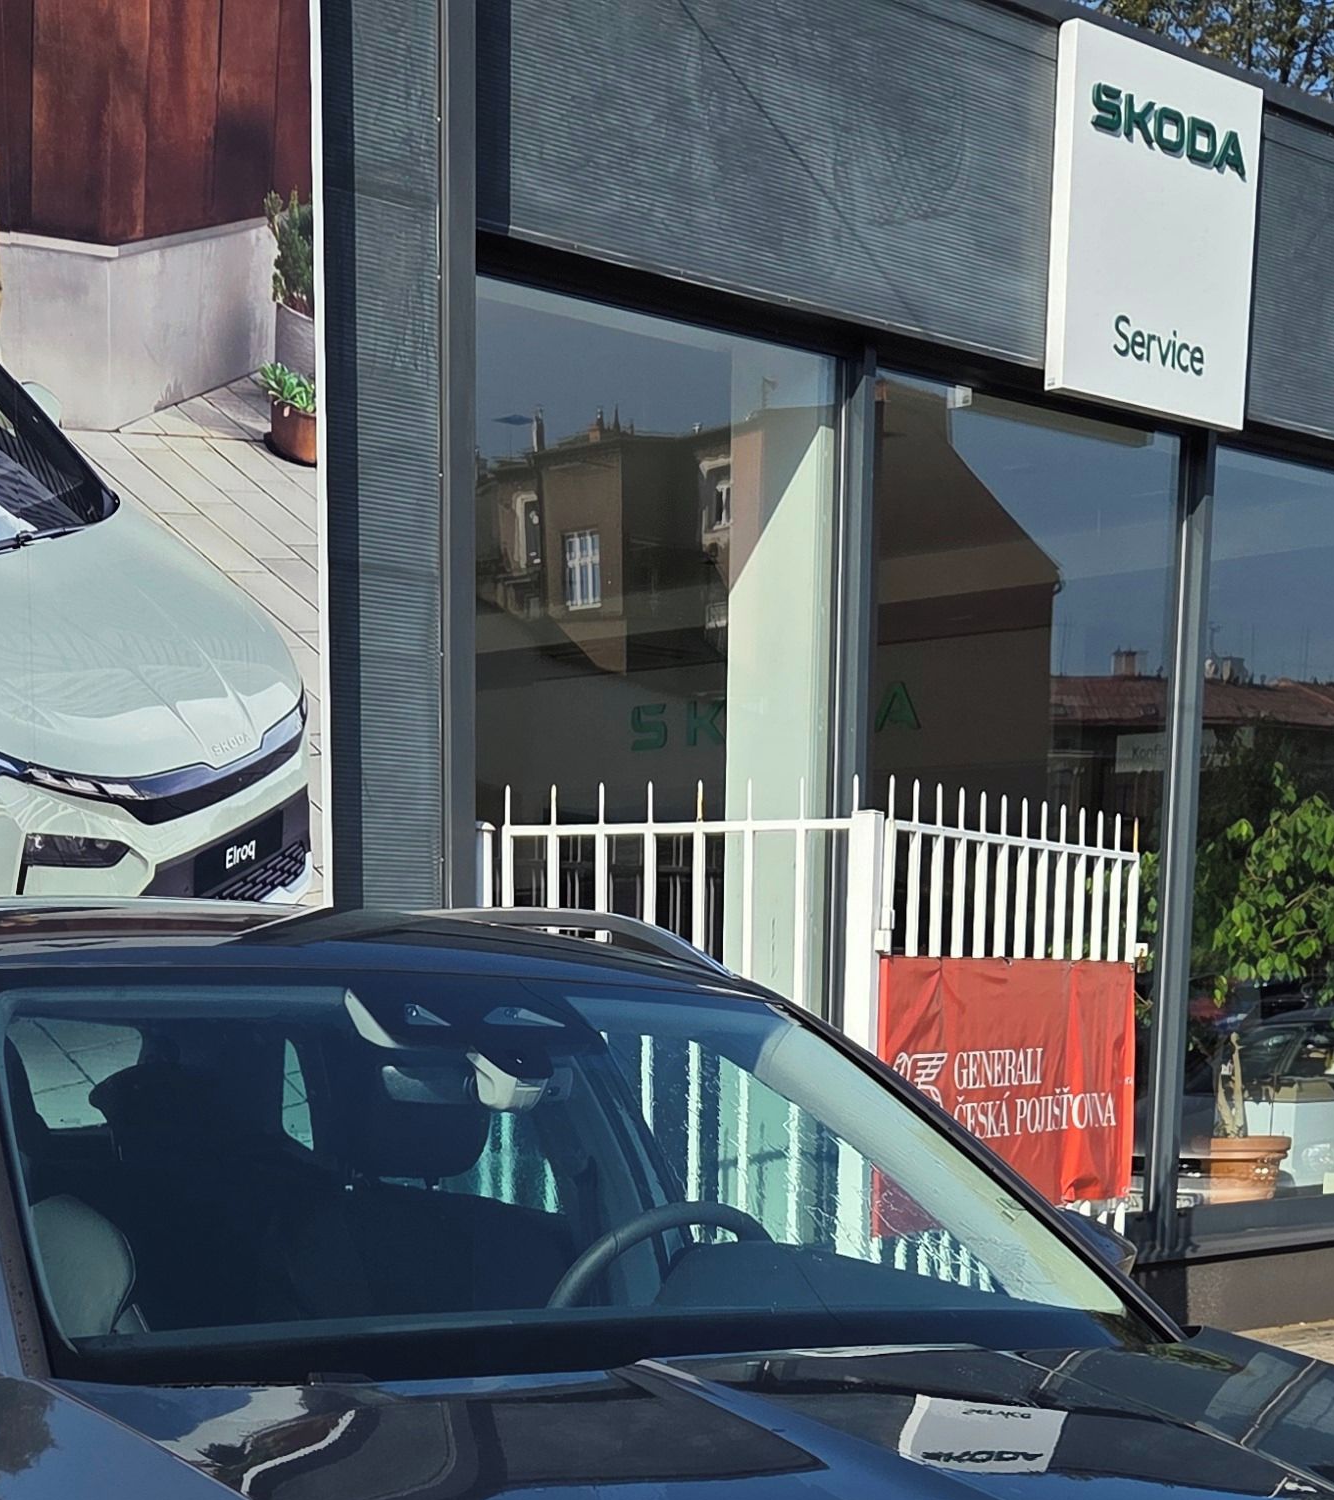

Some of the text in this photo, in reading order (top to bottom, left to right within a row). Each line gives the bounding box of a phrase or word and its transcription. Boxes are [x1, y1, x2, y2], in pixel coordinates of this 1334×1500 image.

[1113, 313, 1205, 377] Service
[630, 680, 922, 751] SKA
[224, 839, 257, 870] Elroq
[953, 1047, 1044, 1090] GENERALI
[953, 1091, 1011, 1140] ČESKÁ
